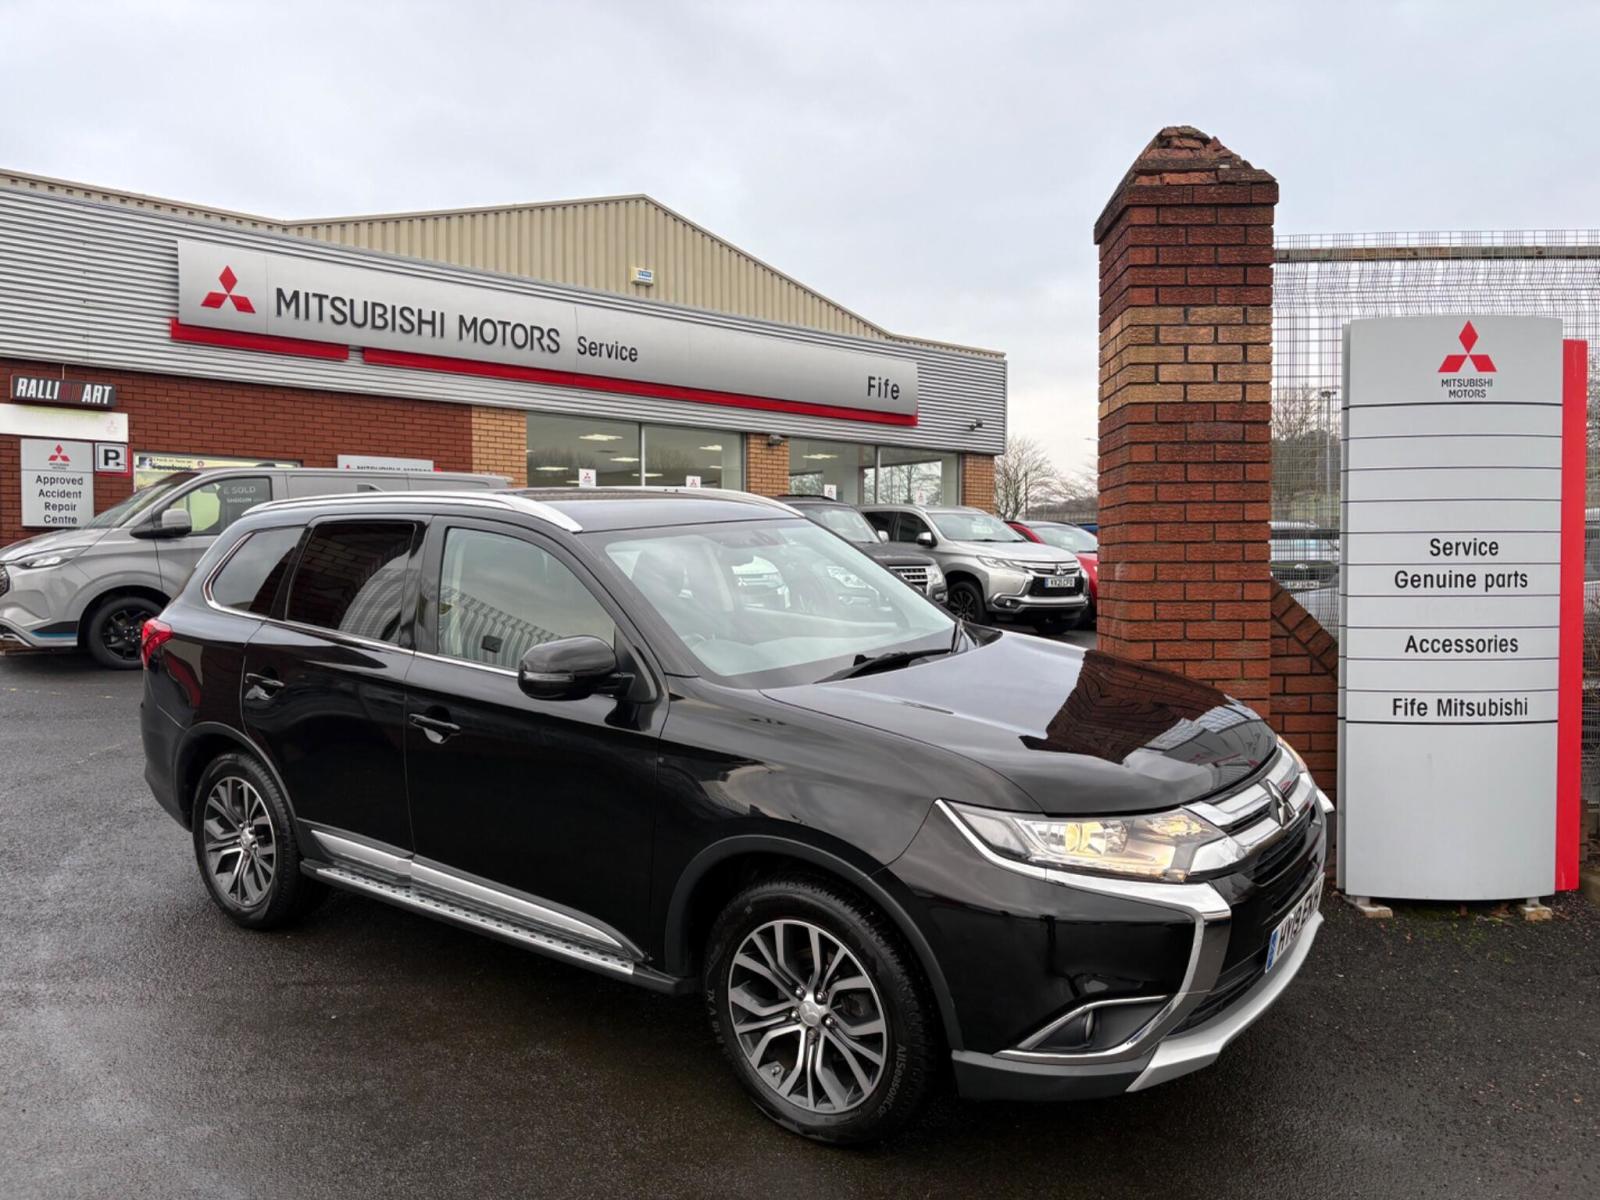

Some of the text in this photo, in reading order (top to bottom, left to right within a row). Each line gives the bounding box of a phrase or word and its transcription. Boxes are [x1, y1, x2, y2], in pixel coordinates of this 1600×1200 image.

[276, 287, 638, 363] MITSUBISHI MOTORS Service
[867, 376, 900, 400] Fife
[1441, 378, 1493, 389] MITSUBISHI
[1448, 389, 1487, 399] MOTORS
[103, 448, 120, 467] P
[35, 474, 84, 487] Approved
[38, 488, 82, 499] Accident
[44, 501, 77, 513] Repair
[43, 514, 78, 525] Centre
[1429, 538, 1499, 557] Service
[1394, 570, 1528, 592] Genuine parts
[1404, 634, 1519, 653] Accessories
[1392, 697, 1528, 717] Fife Mitsubishi
